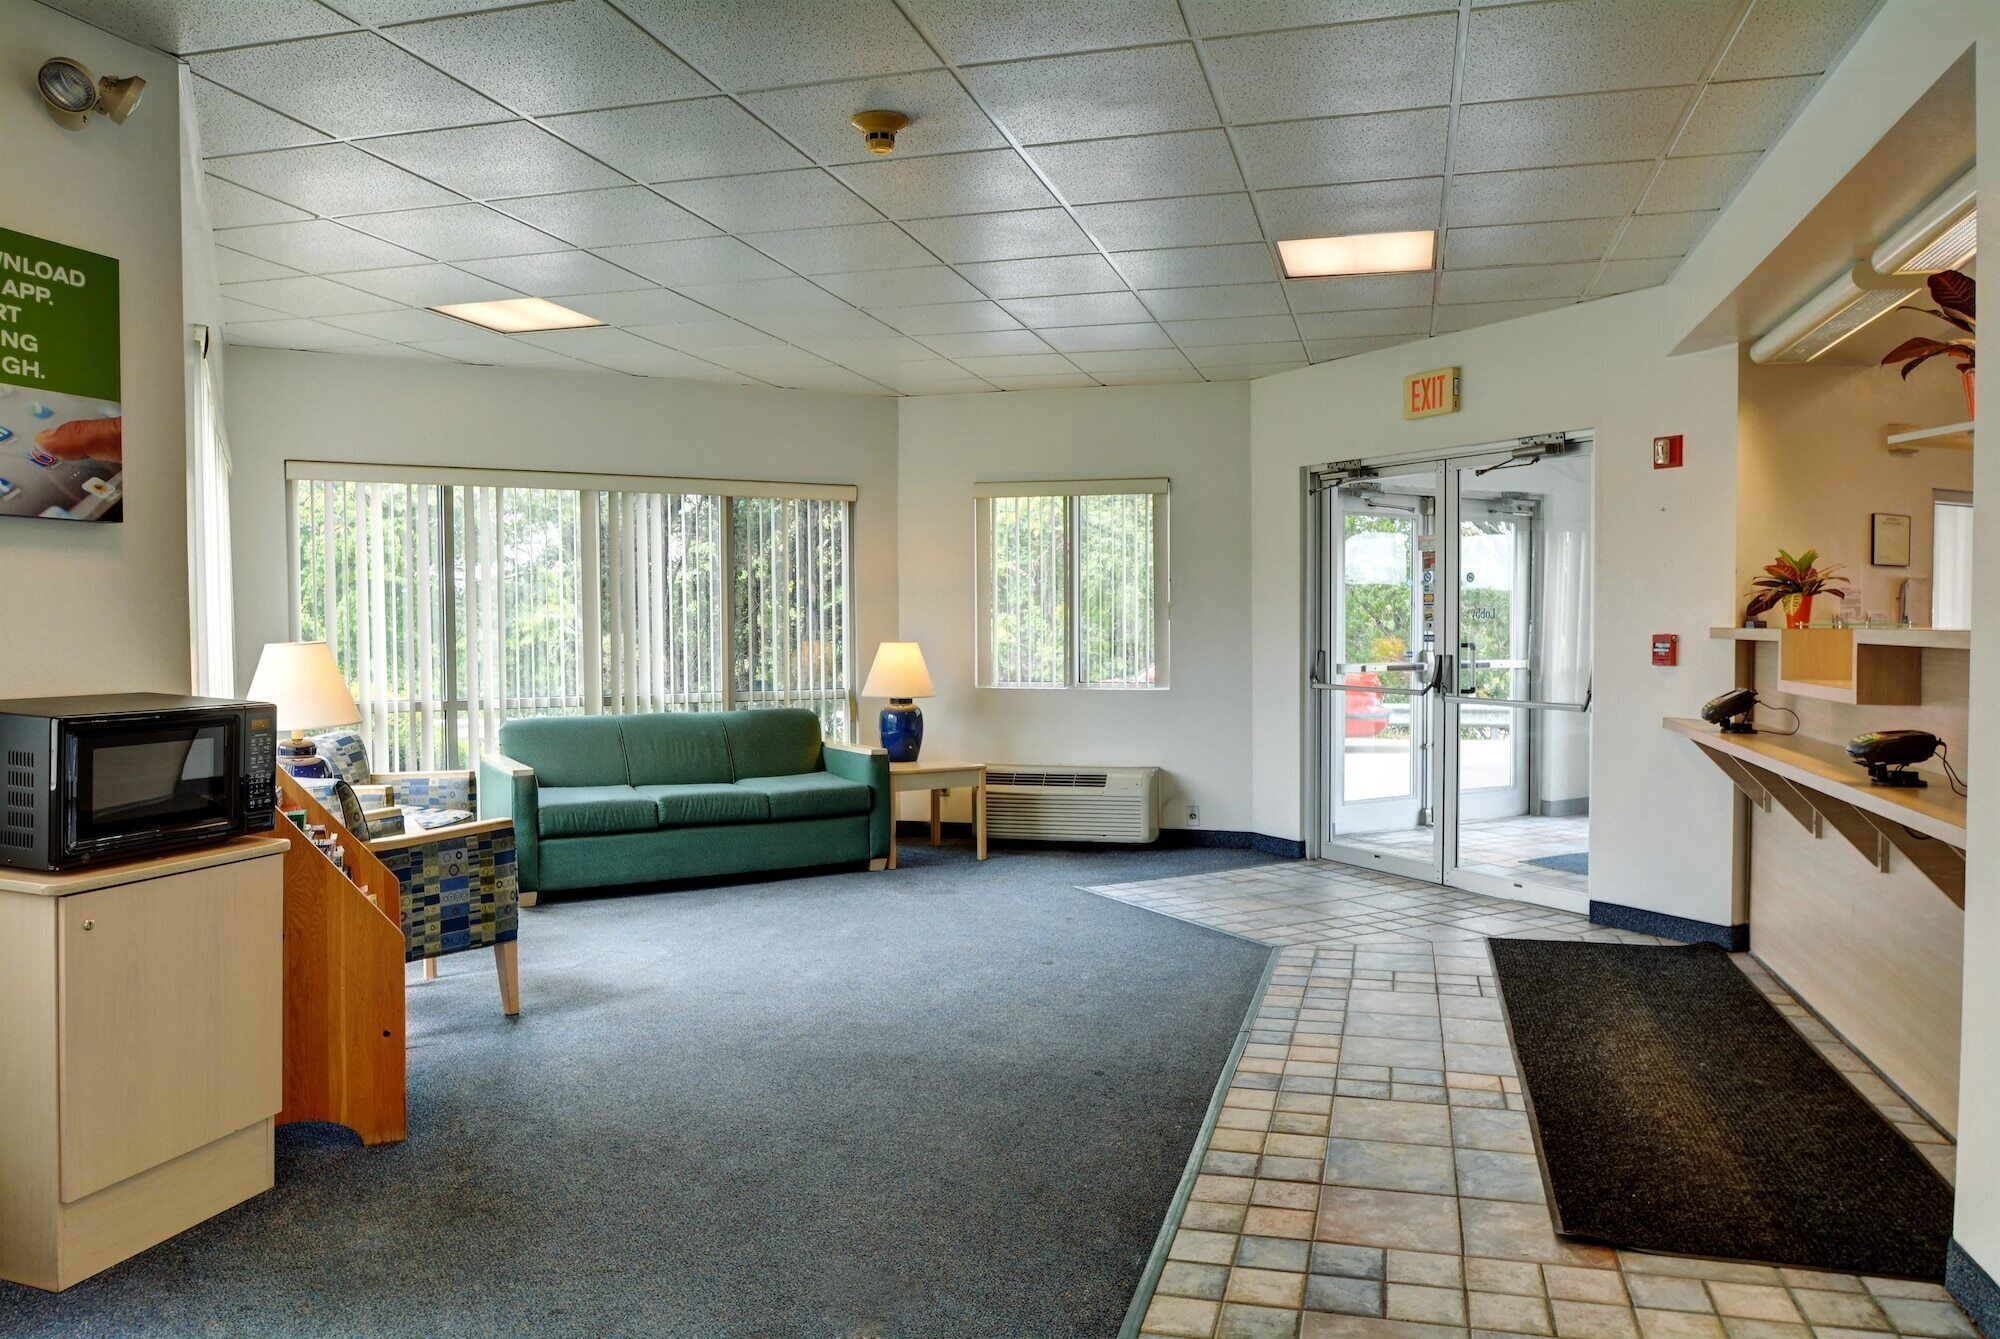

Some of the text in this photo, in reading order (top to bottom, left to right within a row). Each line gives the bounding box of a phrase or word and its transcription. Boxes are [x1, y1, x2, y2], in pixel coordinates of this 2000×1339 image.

[1, 279, 54, 306] APP.
[2, 356, 46, 379] GH.
[1411, 375, 1445, 413] EXIT
